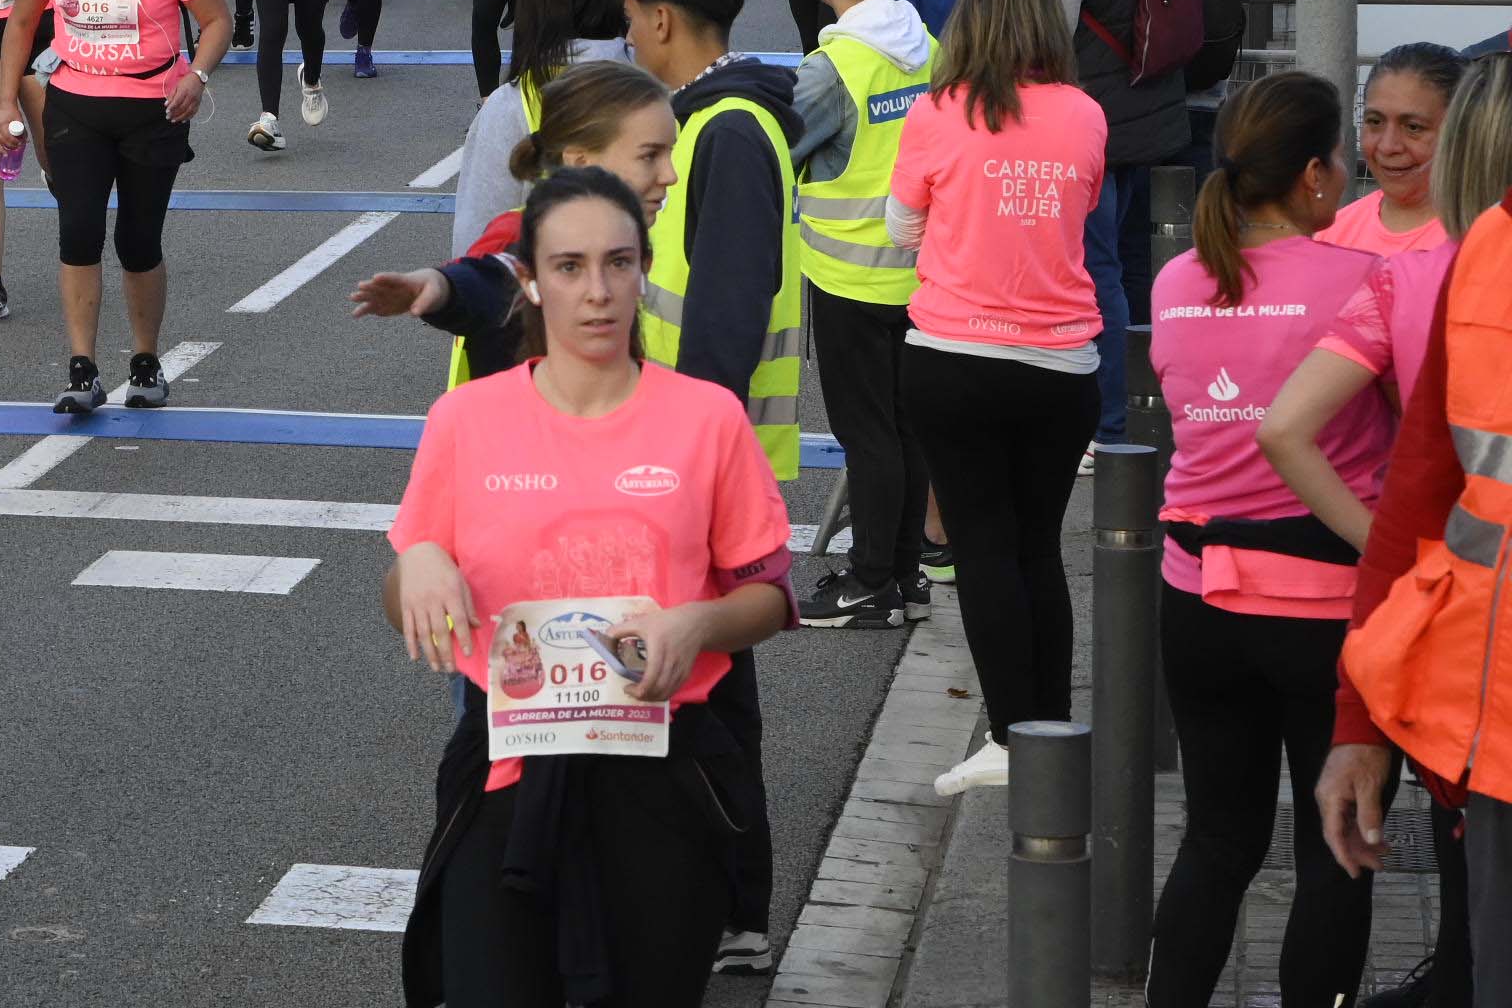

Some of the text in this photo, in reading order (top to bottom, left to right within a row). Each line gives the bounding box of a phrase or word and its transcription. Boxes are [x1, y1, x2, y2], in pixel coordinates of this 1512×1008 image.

[82, 2, 109, 13] 016
[68, 38, 145, 61] DORSAL
[983, 159, 1078, 182] CARRERA
[1002, 178, 1059, 199] DE LA
[997, 199, 1061, 219] MUJER
[1159, 305, 1212, 321] CARRERA
[1236, 305, 1255, 317] LA
[1258, 304, 1306, 317] MUJER
[968, 317, 1021, 336] OYSHO
[484, 474, 559, 492] OYSHO
[619, 473, 676, 492] ASTURIANA
[550, 661, 608, 685] 016
[555, 689, 600, 704] 11100
[508, 708, 652, 723] CARRERA DE LA MUJER 2023
[505, 730, 557, 746] OYSHO
[599, 730, 655, 743] Santander
